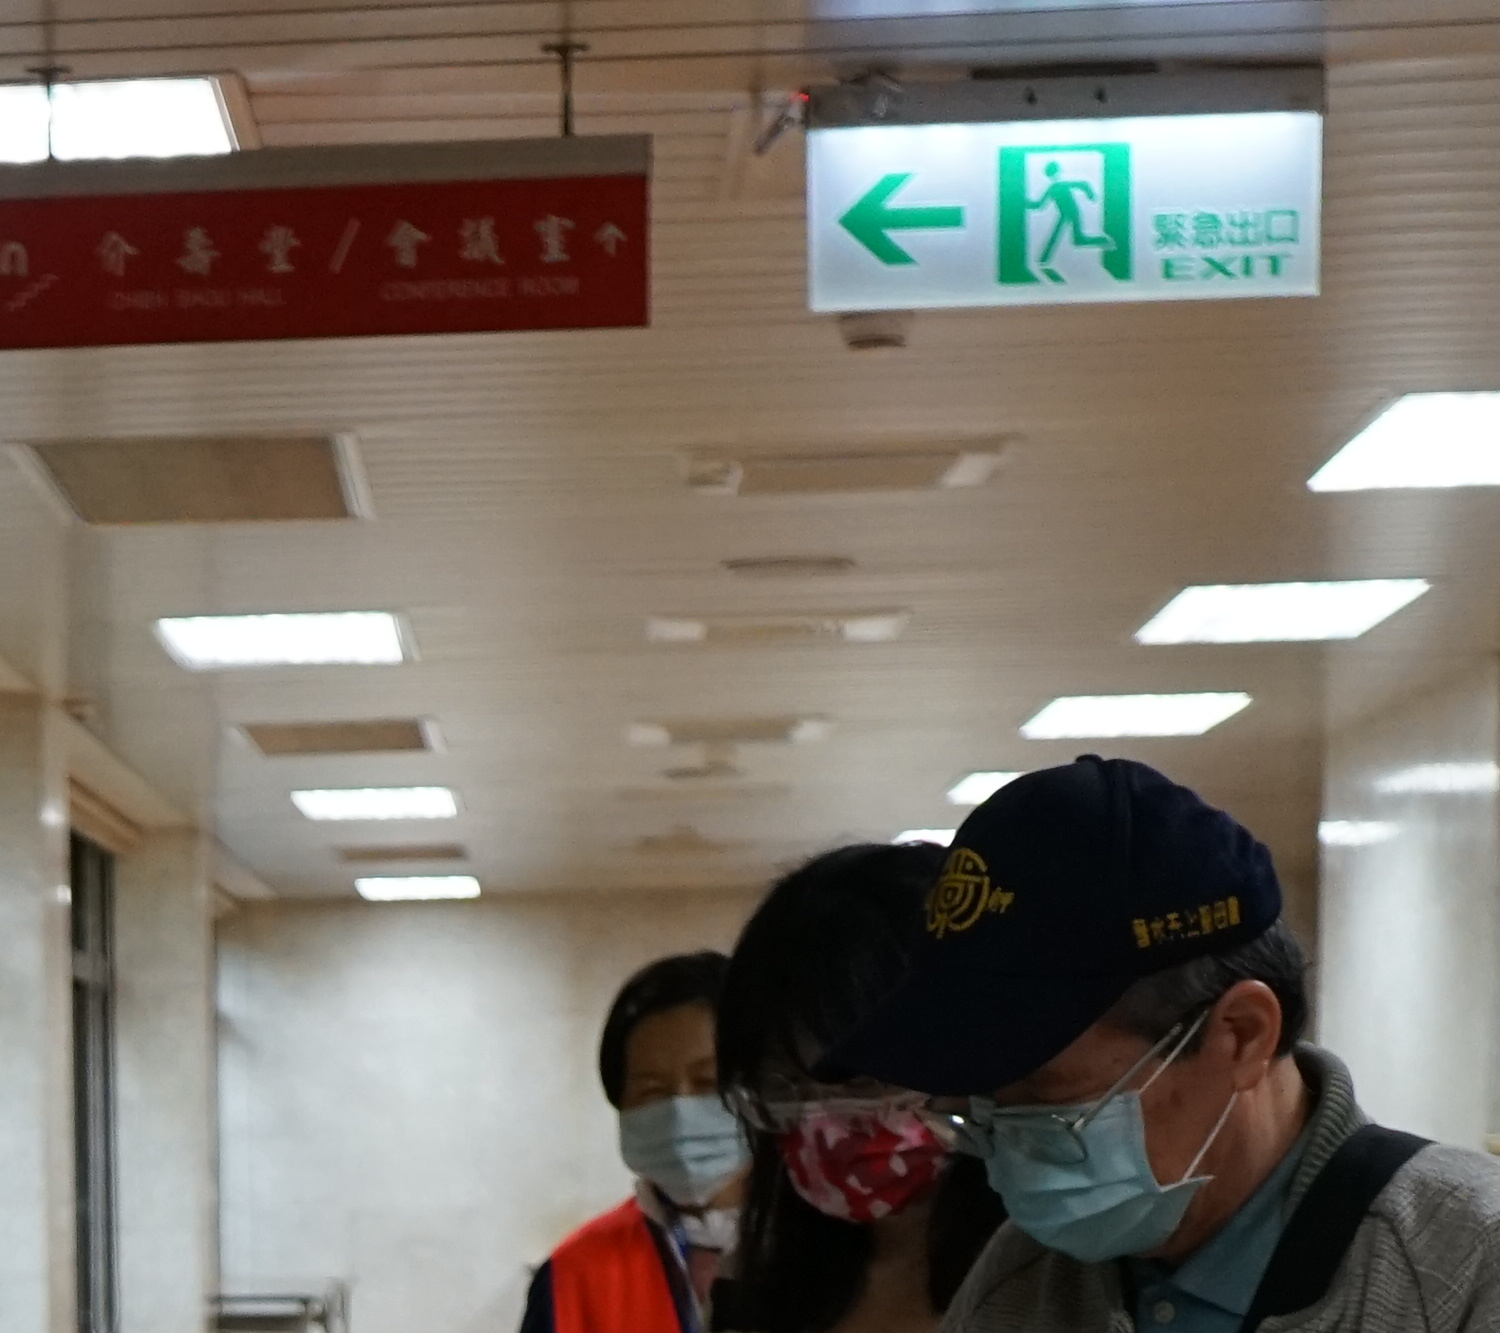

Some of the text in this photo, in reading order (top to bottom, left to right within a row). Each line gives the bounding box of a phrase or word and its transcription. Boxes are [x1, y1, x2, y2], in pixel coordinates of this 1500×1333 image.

[1154, 210, 1298, 247] 緊急出口
[1160, 254, 1292, 279] EXIT
